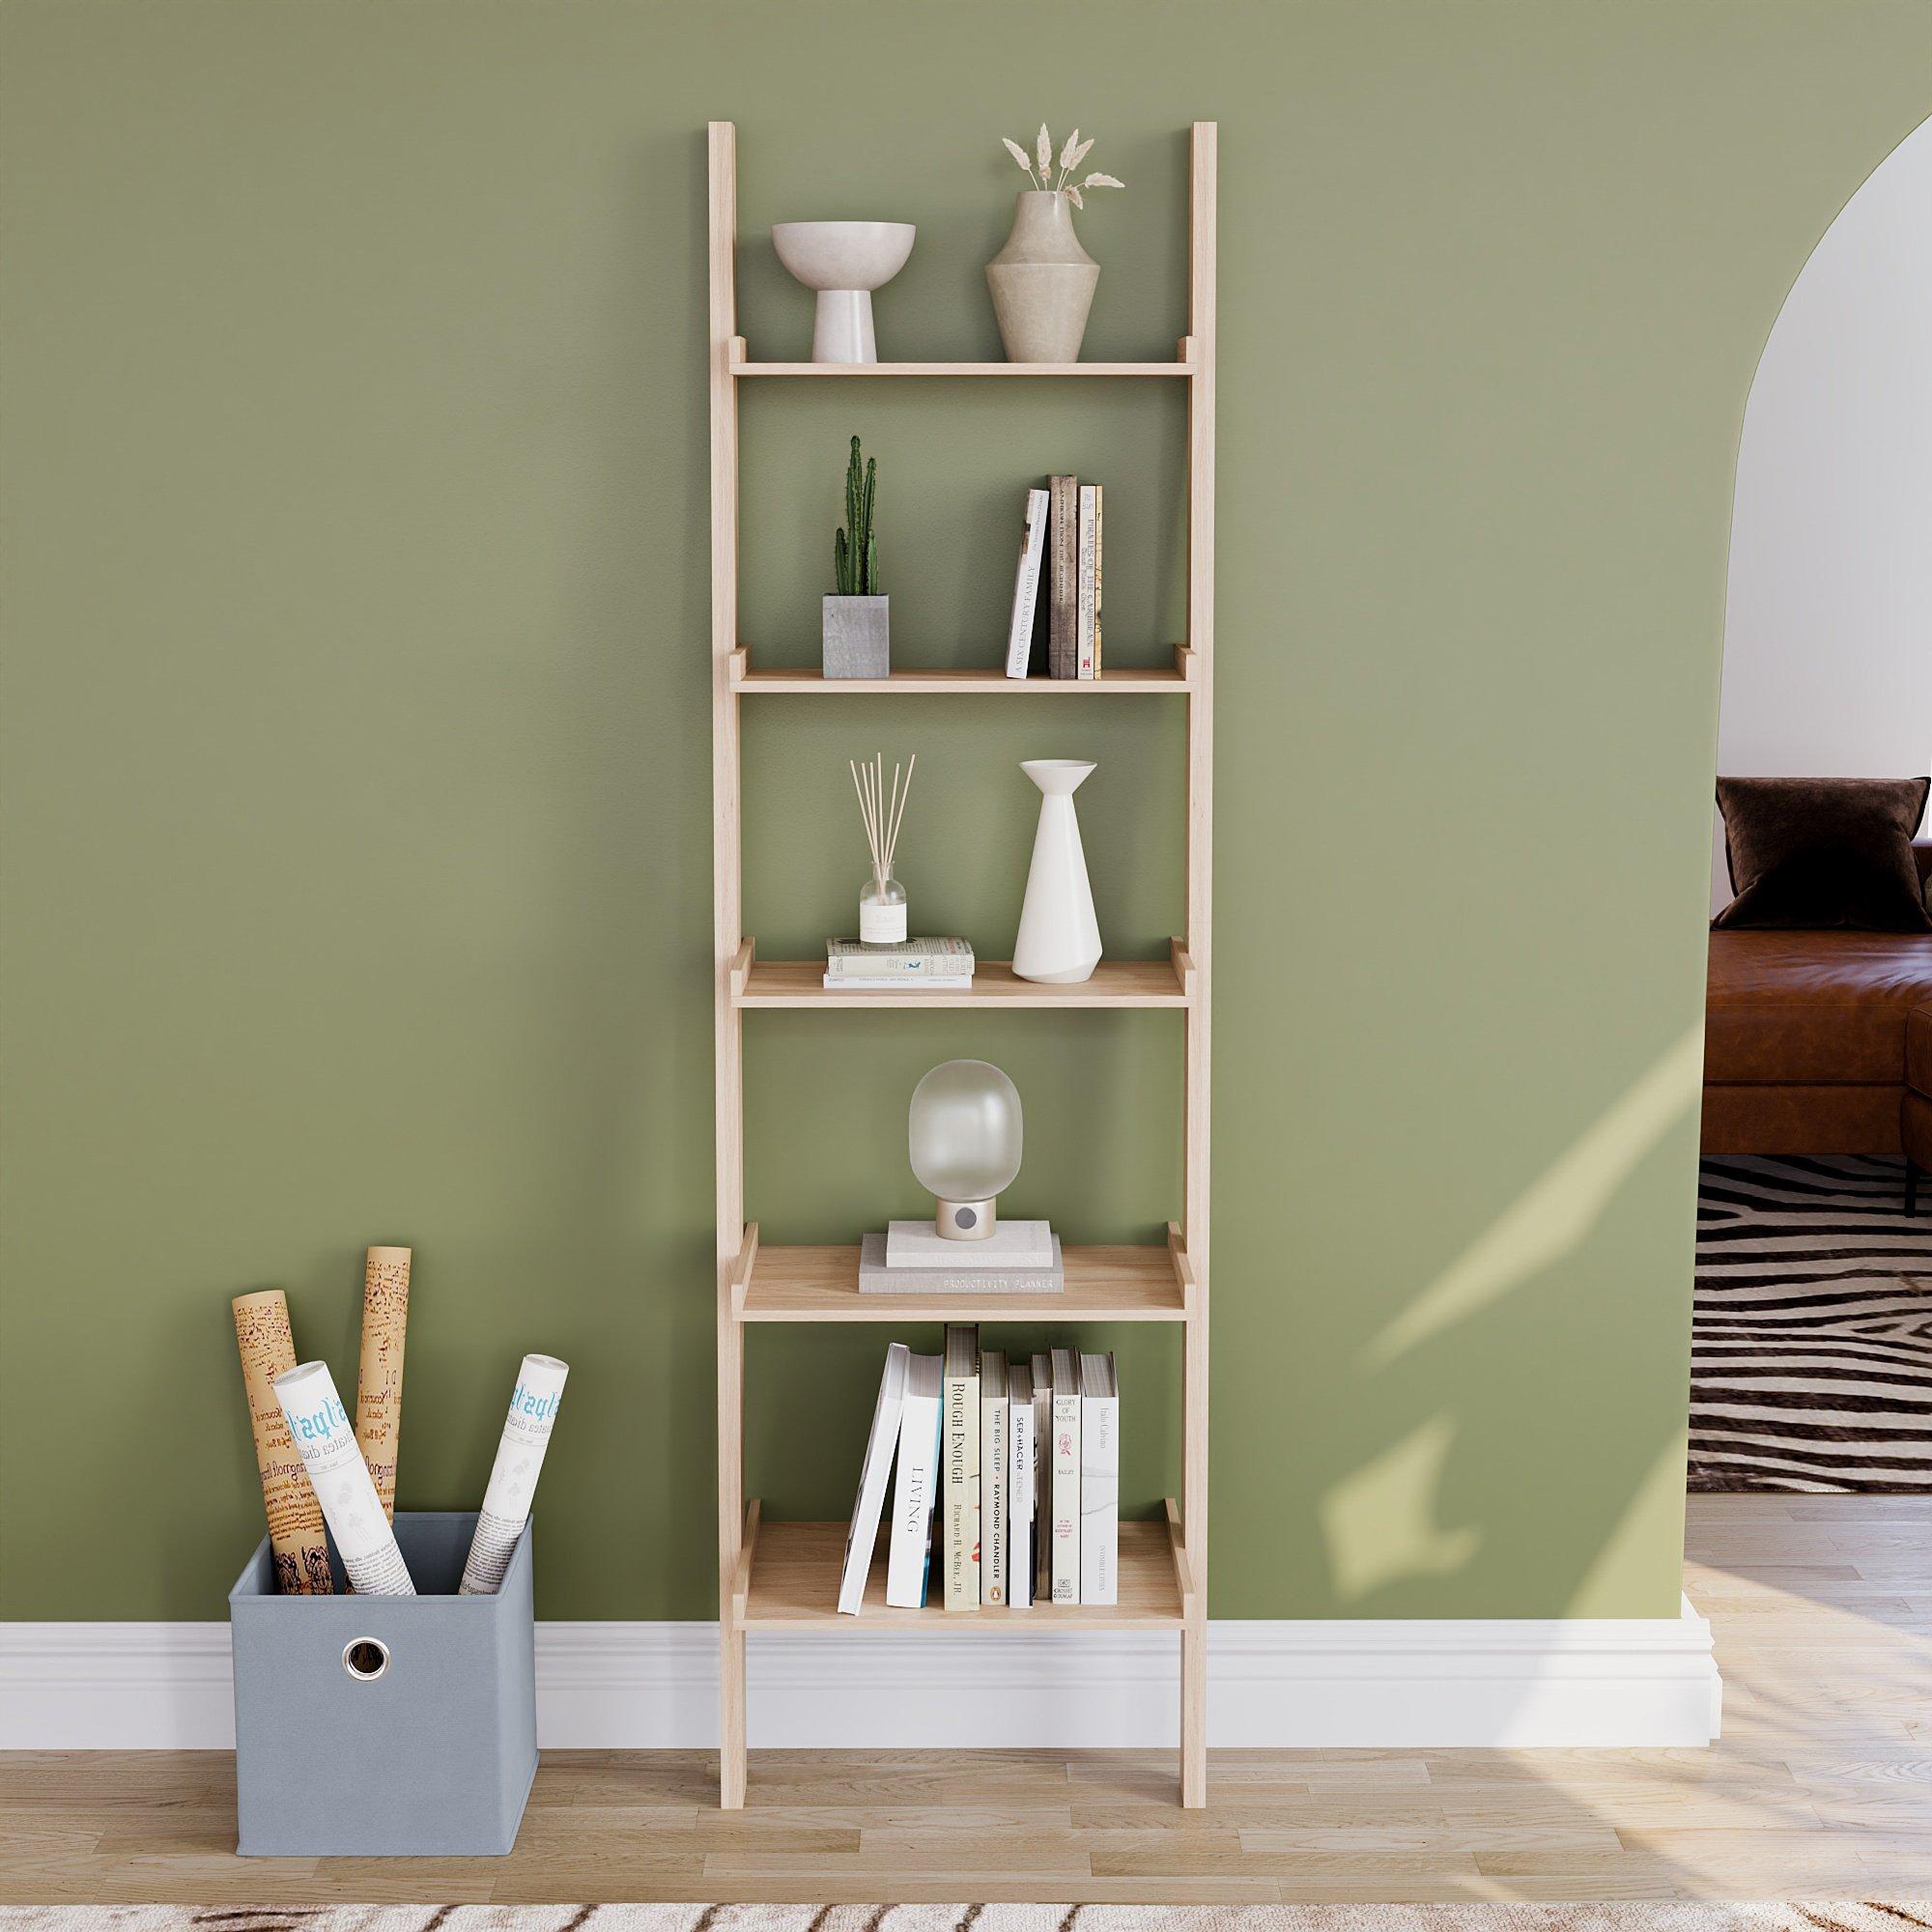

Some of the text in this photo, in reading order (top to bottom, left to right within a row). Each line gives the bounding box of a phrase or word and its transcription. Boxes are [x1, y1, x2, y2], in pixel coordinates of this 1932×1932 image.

[1024, 565, 1036, 602] FAMILY
[1018, 604, 1031, 646] CENTURY
[943, 1279, 1054, 1288] PRODUCTIVITY PLANNER
[952, 1382, 966, 1485] ROUGH ENOUGH
[1098, 1406, 1109, 1449] Italo Calvino
[907, 1467, 924, 1534] LIVING
[952, 1504, 962, 1538] RICHARD
[952, 1539, 962, 1548] H.
[952, 1581, 962, 1597] JR.
